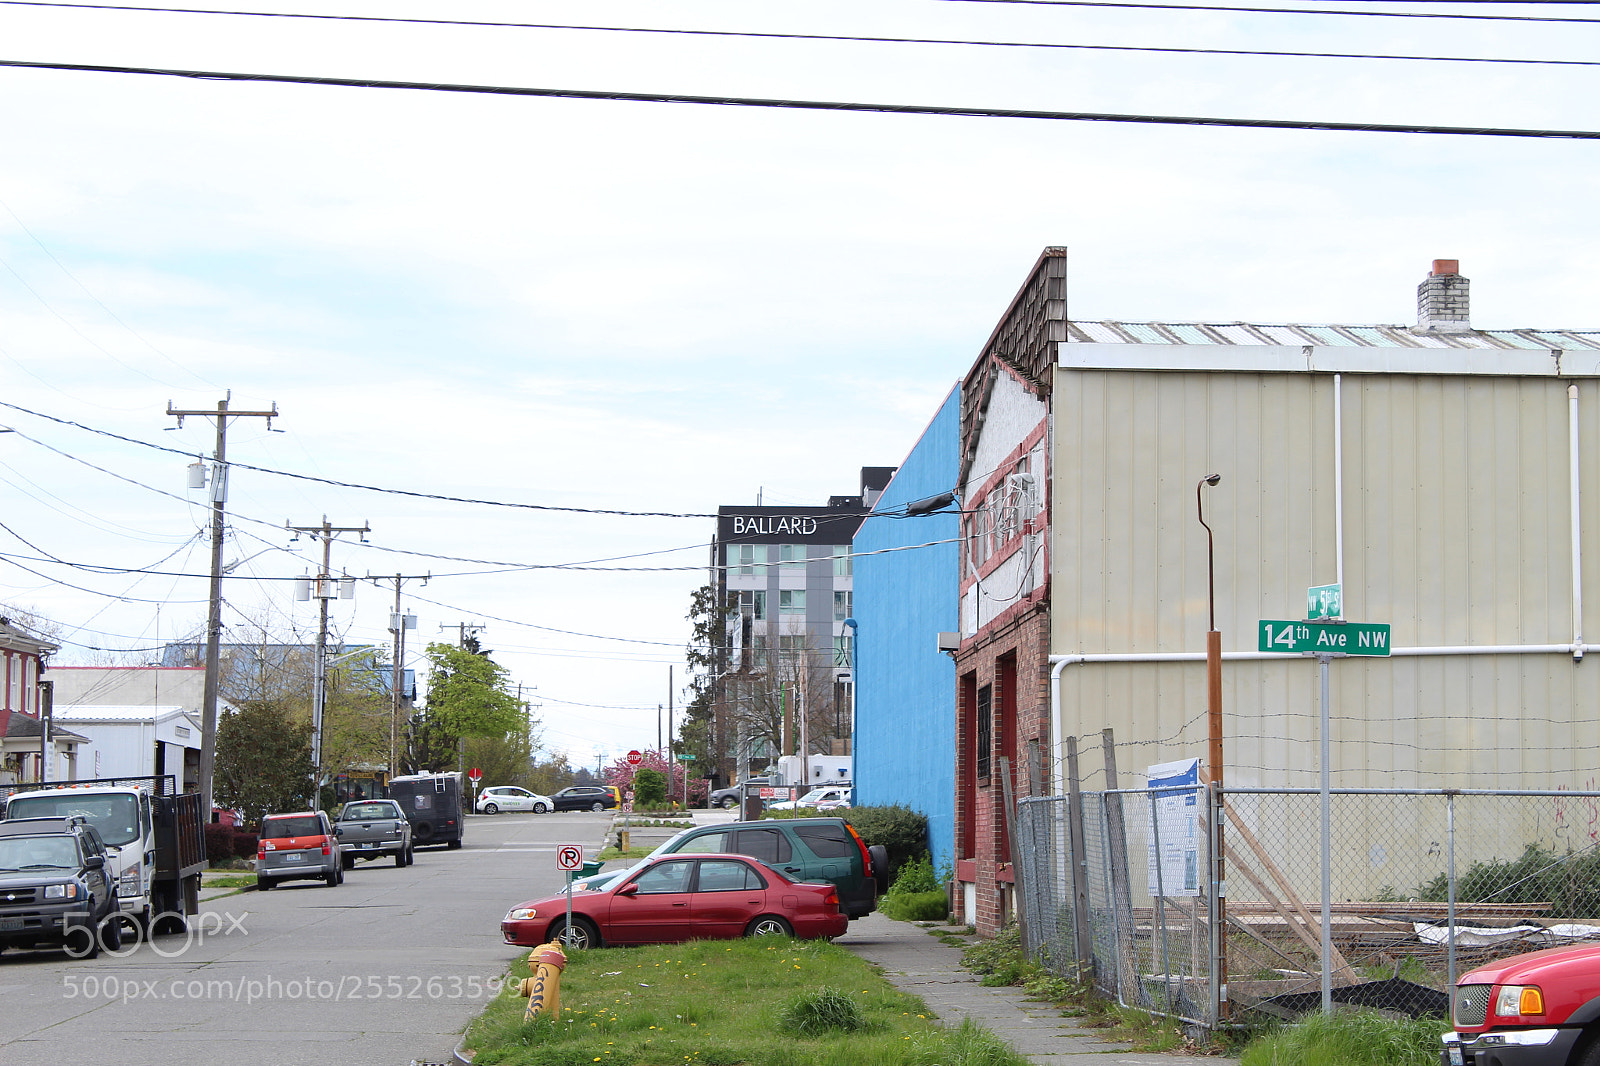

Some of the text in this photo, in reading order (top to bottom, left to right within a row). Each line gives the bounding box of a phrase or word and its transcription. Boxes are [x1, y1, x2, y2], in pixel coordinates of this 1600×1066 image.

[734, 516, 817, 535] BALLARD
[1265, 624, 1387, 649] 14th Ave NW
